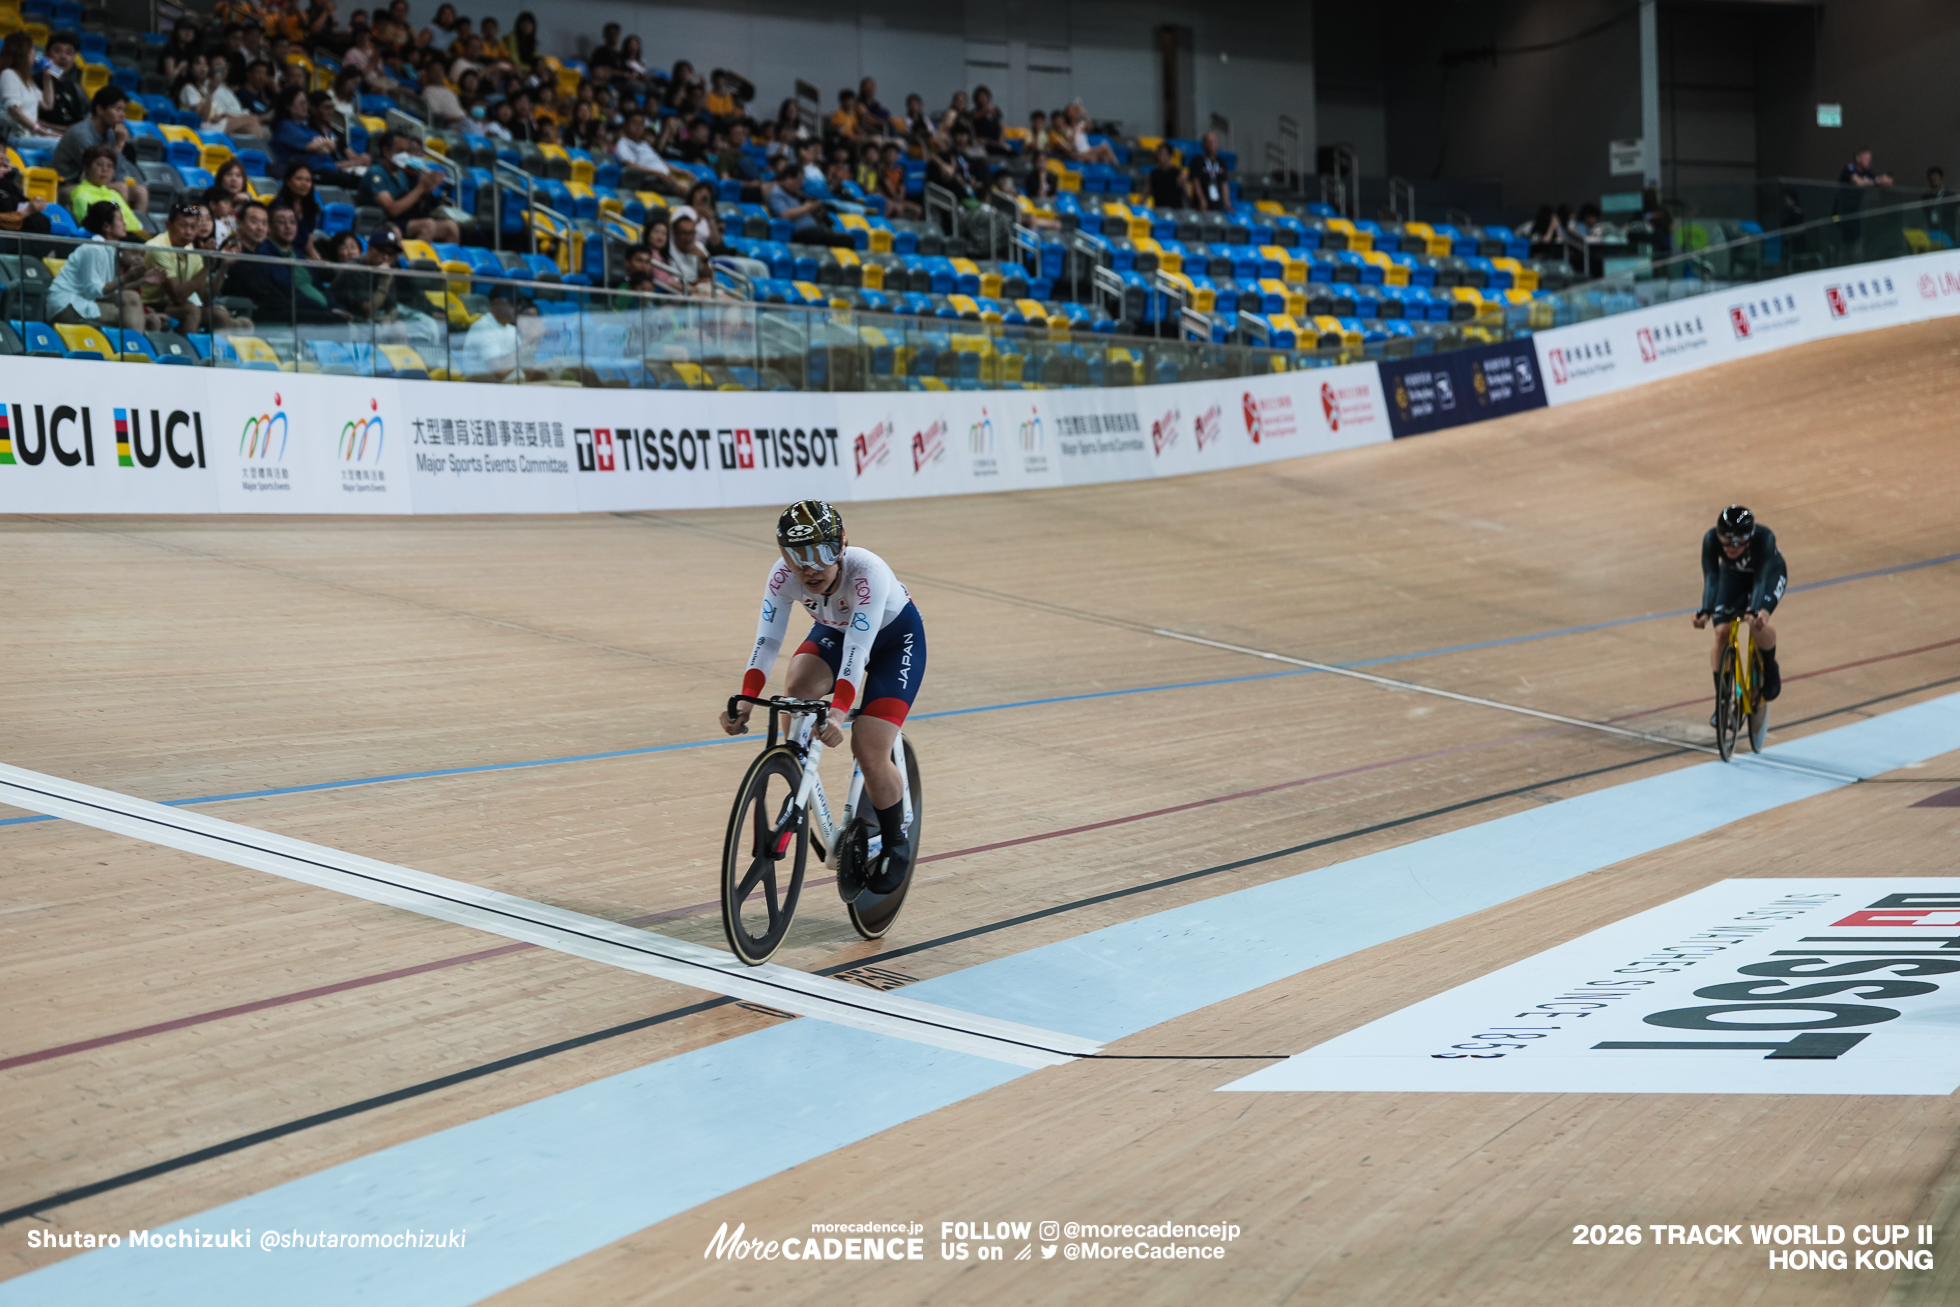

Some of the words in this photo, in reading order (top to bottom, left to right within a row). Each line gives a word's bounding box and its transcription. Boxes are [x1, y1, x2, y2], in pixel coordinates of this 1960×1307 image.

[11, 403, 95, 466] UCI
[131, 408, 206, 469] UCI
[615, 429, 711, 471] TISSOT
[754, 428, 839, 468] TISSOT
[416, 453, 446, 476] Major
[449, 454, 482, 477] Sports
[484, 454, 517, 473] Events
[519, 455, 569, 474] Committee
[898, 633, 914, 690] JAPAN
[1514, 980, 1656, 1018] SINCE
[1431, 1026, 1562, 1058] 1853
